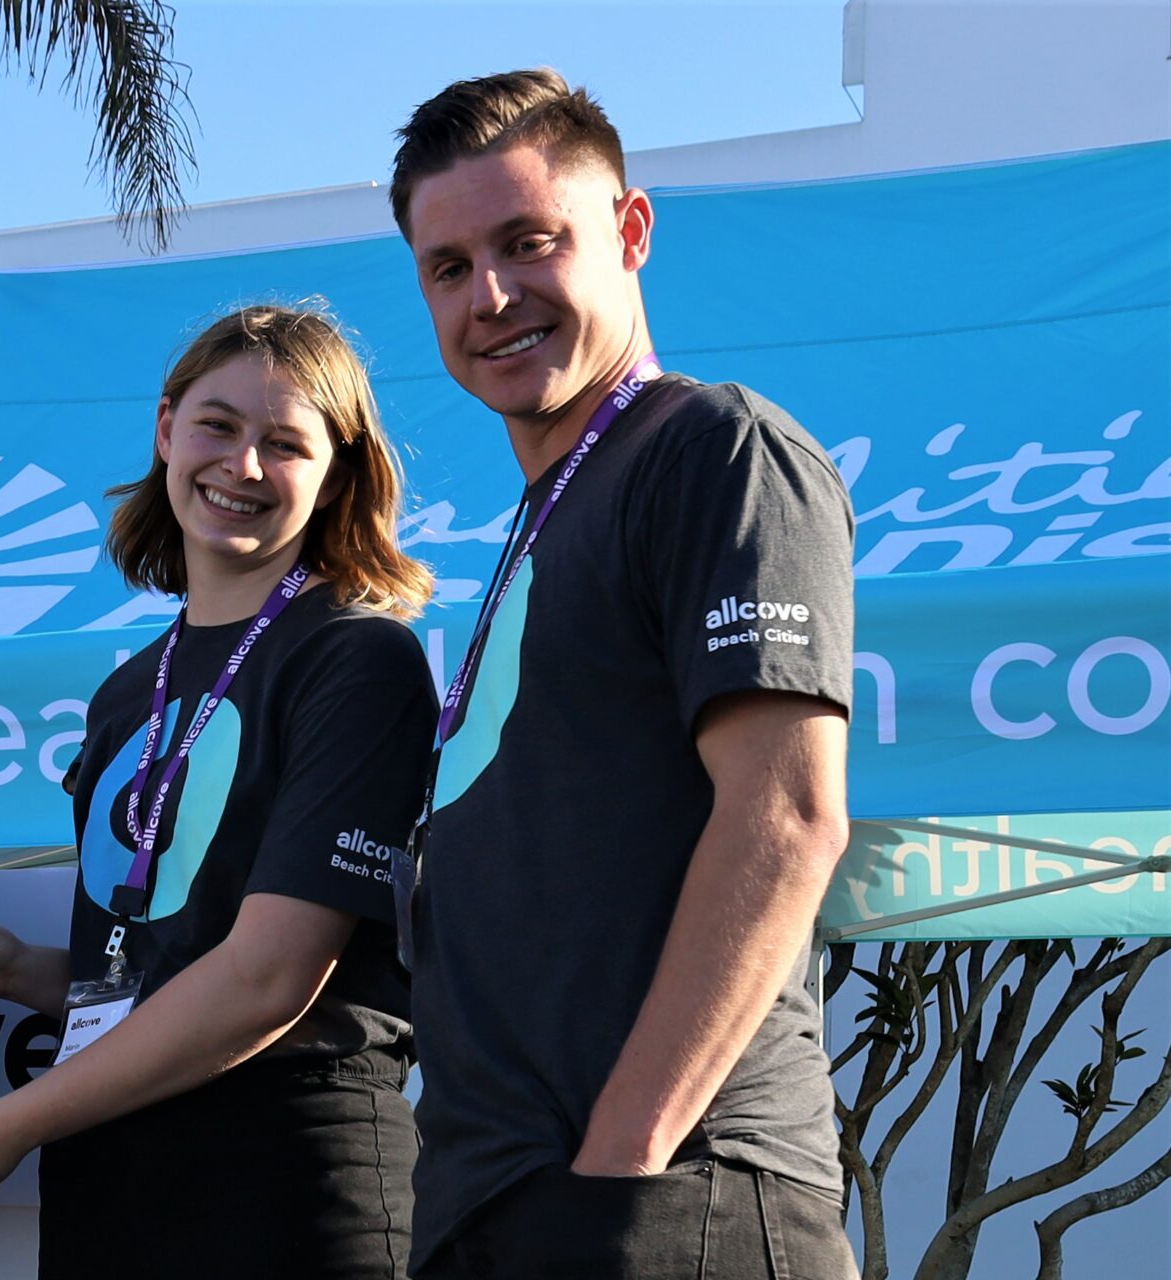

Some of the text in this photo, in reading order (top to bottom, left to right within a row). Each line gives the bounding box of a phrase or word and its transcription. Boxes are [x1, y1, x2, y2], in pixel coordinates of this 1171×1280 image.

[550, 430, 600, 502] allcove
[705, 596, 810, 630] allcove
[707, 628, 809, 652] Beach Cities
[227, 616, 271, 676] allcove
[137, 711, 161, 771] allcove
[178, 697, 219, 759] allcove
[143, 782, 169, 851] allcove
[330, 853, 395, 885] Beach Cit
[70, 1016, 101, 1031] allcove
